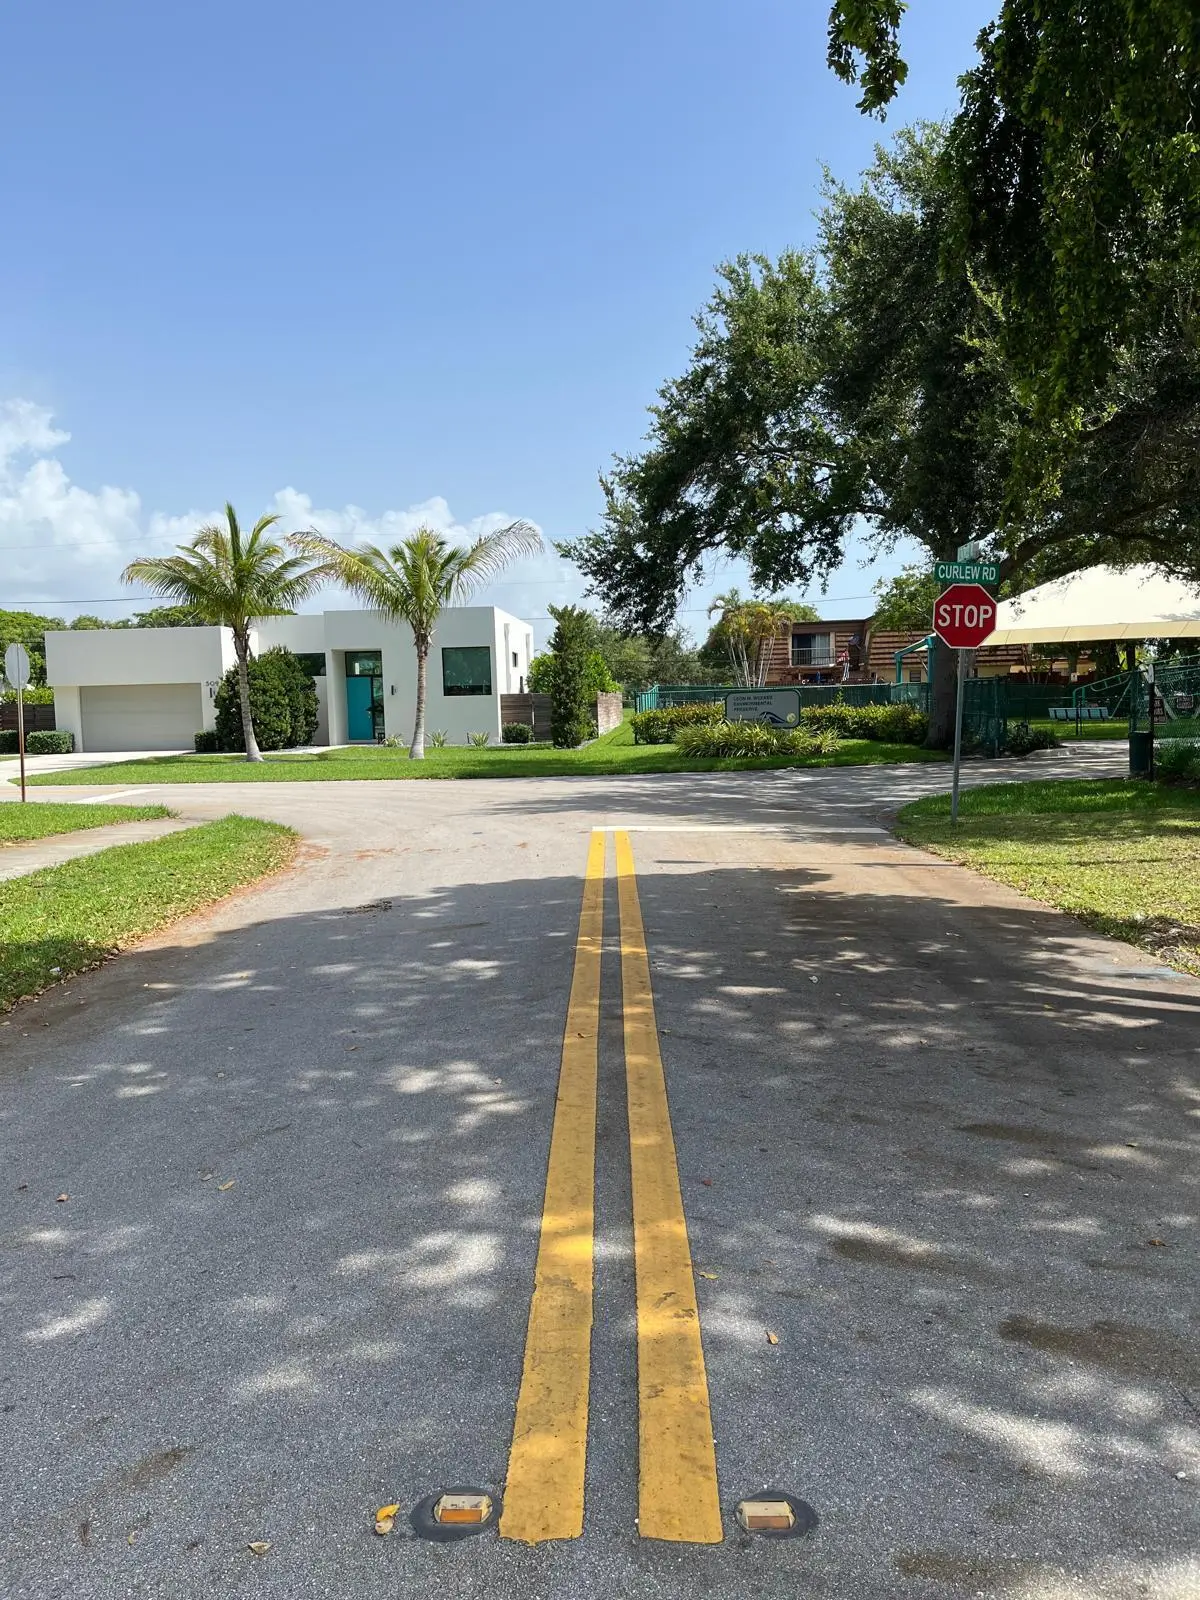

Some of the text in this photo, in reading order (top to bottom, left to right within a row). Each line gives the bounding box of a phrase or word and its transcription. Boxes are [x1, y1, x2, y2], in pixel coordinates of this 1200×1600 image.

[938, 565, 996, 580] CURLEW RD
[937, 604, 993, 628] STOP
